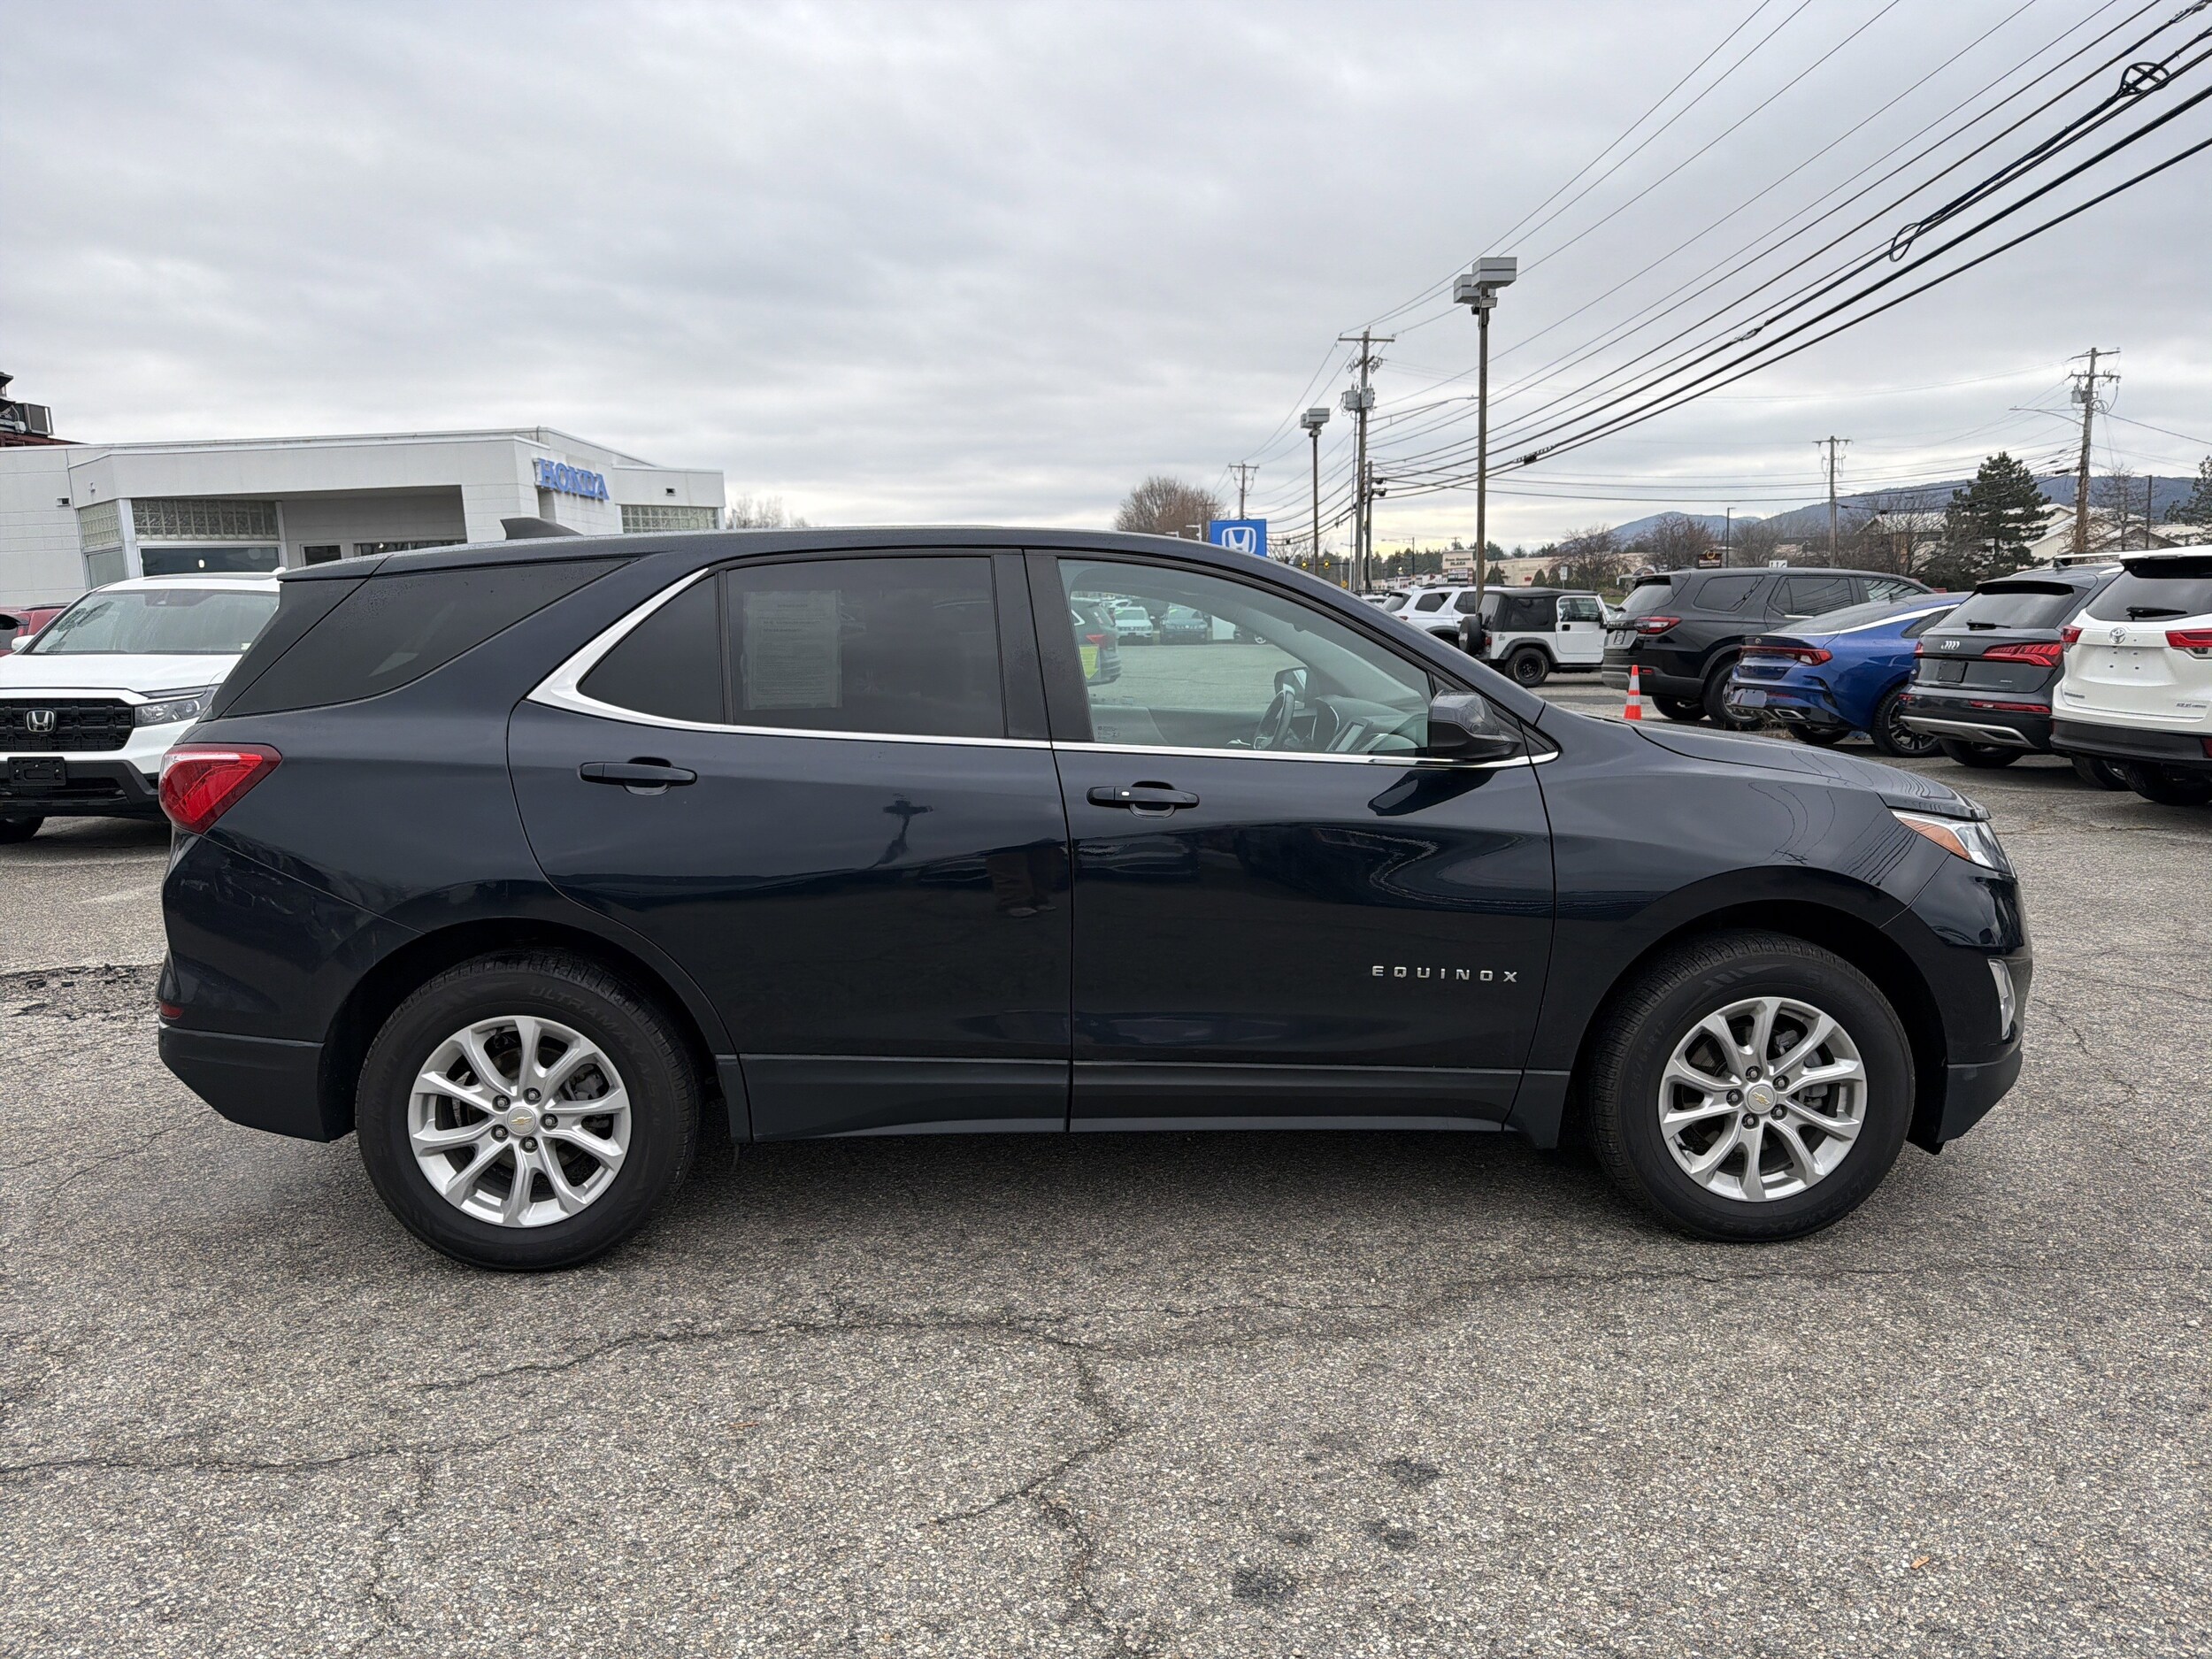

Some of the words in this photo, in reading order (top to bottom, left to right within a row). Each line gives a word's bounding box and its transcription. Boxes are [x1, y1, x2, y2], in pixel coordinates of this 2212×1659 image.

[534, 458, 610, 500] HONDA
[1372, 965, 1517, 983] EQUINOX
[528, 987, 643, 1056] ULTRAMAX
